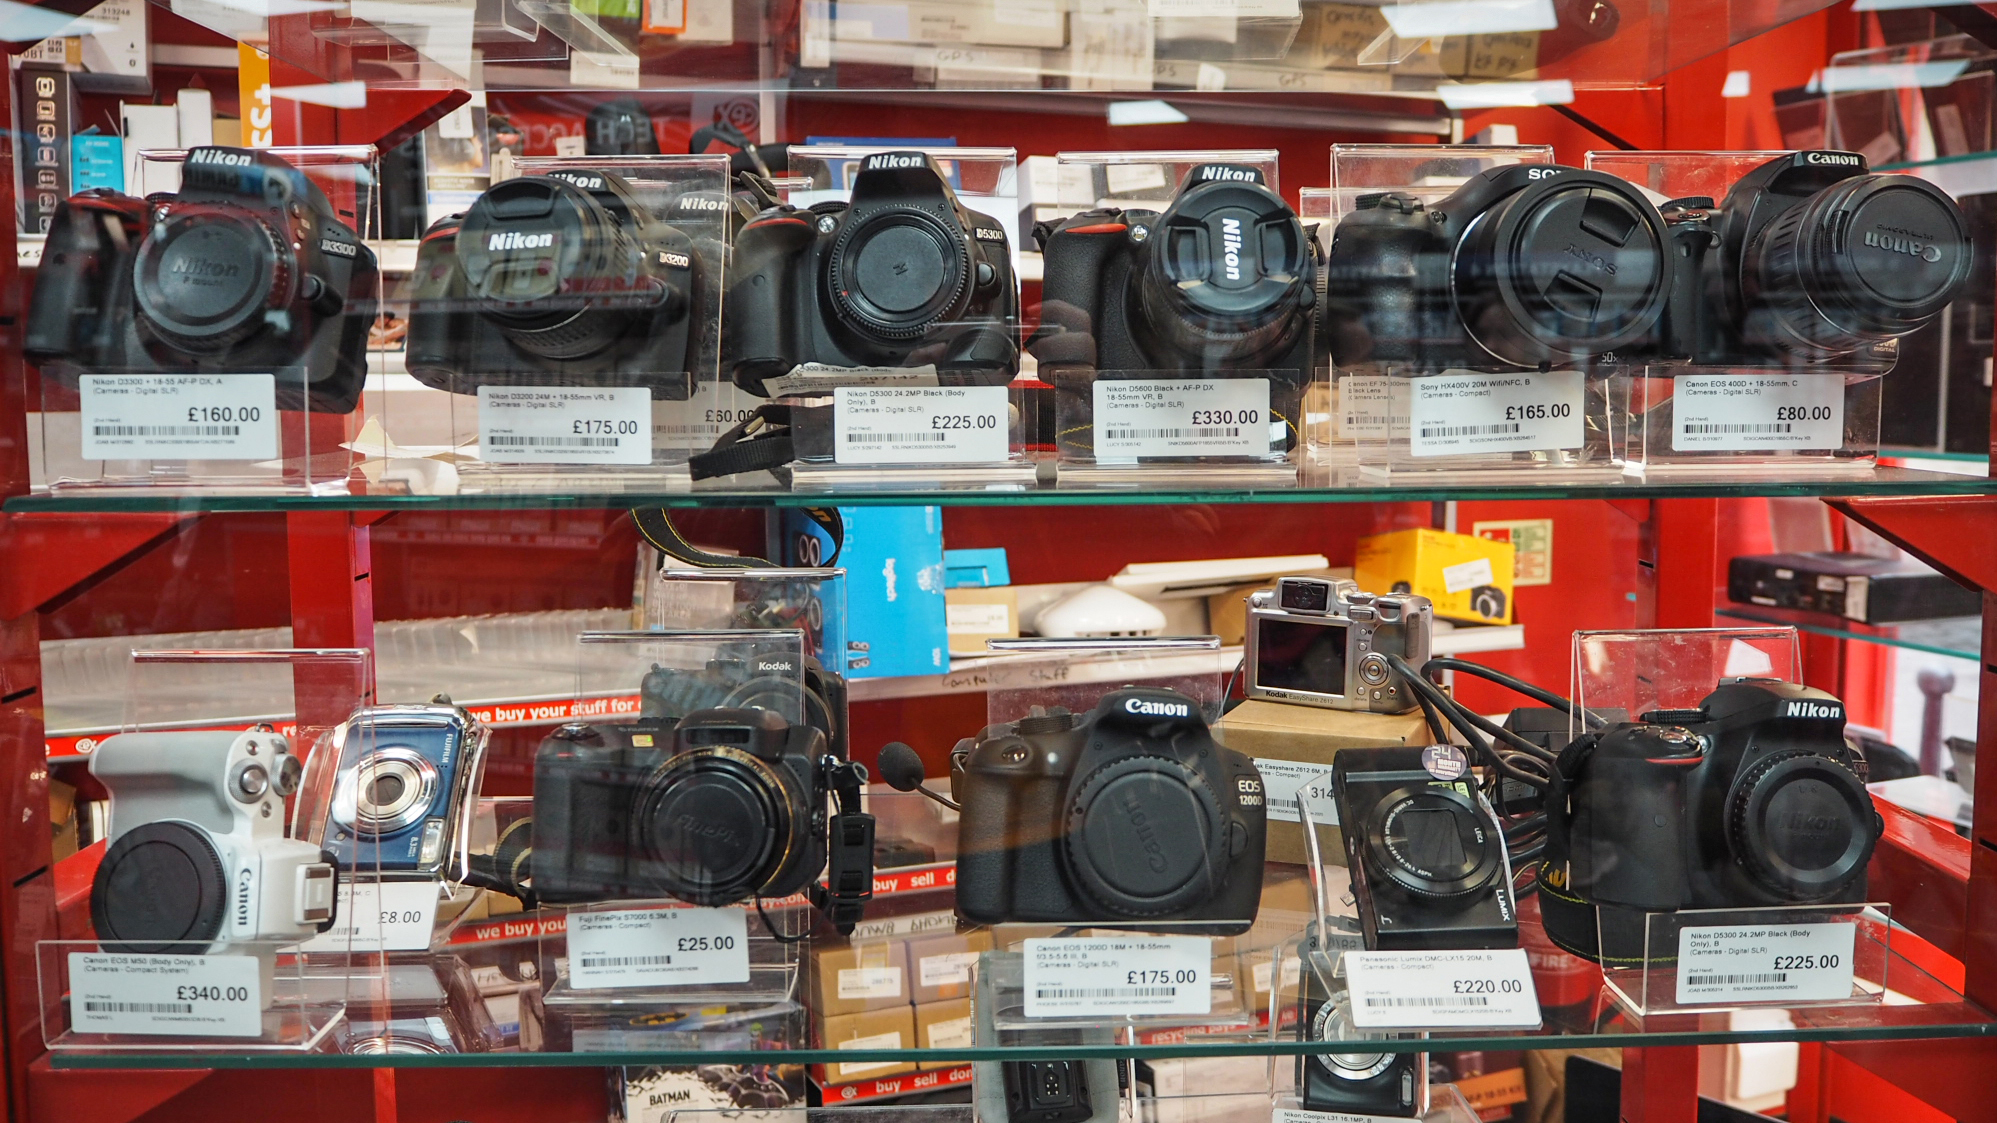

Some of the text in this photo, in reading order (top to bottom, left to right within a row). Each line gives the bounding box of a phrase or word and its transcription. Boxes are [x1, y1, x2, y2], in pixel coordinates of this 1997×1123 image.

[191, 149, 252, 166] Nikon
[868, 155, 922, 169] Nikon
[1807, 152, 1859, 166] Canon
[1202, 166, 1256, 182] Nikon
[680, 198, 729, 211] Nikon
[489, 232, 552, 251] Nikon
[975, 228, 1003, 240] D5300
[321, 238, 357, 258] D3300
[1222, 218, 1242, 281] Nikon
[1864, 231, 1942, 263] Canon
[659, 252, 689, 267] D3200
[1564, 243, 1618, 276] SONY
[172, 257, 240, 278] Nikon
[92, 378, 115, 386] Nikon
[117, 378, 143, 386] D3300
[1421, 384, 1439, 392] Sony
[1440, 383, 1470, 391] HX400V
[1488, 380, 1523, 388] Wifi/NFC,
[1756, 380, 1790, 388] 18-55mm,
[945, 390, 965, 398] (Body
[1420, 389, 1491, 399] (Cameras Compact)
[885, 406, 906, 414] Digital
[1145, 401, 1166, 409] Digital
[1167, 401, 1184, 409] SLR)
[1505, 404, 1571, 420] £165.00
[188, 407, 260, 422] £160.00
[1192, 410, 1258, 425] £330.00
[1777, 406, 1831, 420] £80.00
[573, 420, 638, 434] £175.00
[932, 415, 996, 429] £225.00
[882, 558, 897, 602] logitech
[758, 661, 792, 671] Kodak
[1265, 689, 1334, 705] Kodak EasyShare Z612
[496, 707, 525, 722] buy
[530, 705, 566, 720] your
[570, 702, 607, 716] stuff
[611, 699, 634, 712] for
[1125, 698, 1188, 717] Canon
[1787, 702, 1840, 718] Nikon
[441, 733, 453, 763] FUJIFILM
[1431, 746, 1451, 759] 24
[1265, 764, 1294, 772] Easyshare
[1275, 771, 1300, 779] Compact)
[1238, 780, 1261, 793] EOS
[1311, 786, 1335, 800] 314
[1238, 794, 1263, 806] 1200D
[1122, 796, 1168, 874] Canon
[1474, 827, 1484, 844] LEICA
[873, 872, 935, 893] buy sell
[237, 867, 252, 926] Canon
[1496, 889, 1511, 921] LUMIX
[378, 910, 421, 924] £8.00
[594, 914, 622, 922] FinePix
[475, 918, 567, 940] we buy you
[1790, 930, 1811, 938] (Body
[677, 936, 734, 951] £25.00
[1690, 948, 1722, 956] (Cameras
[1728, 947, 1749, 955] Digital
[1774, 954, 1839, 970] £225.00
[1127, 969, 1196, 984] £175.00
[177, 986, 248, 1001] £340.00
[1453, 980, 1522, 993] £220.00
[876, 1066, 972, 1094] buy sell don
[649, 1089, 691, 1106] BATMAN
